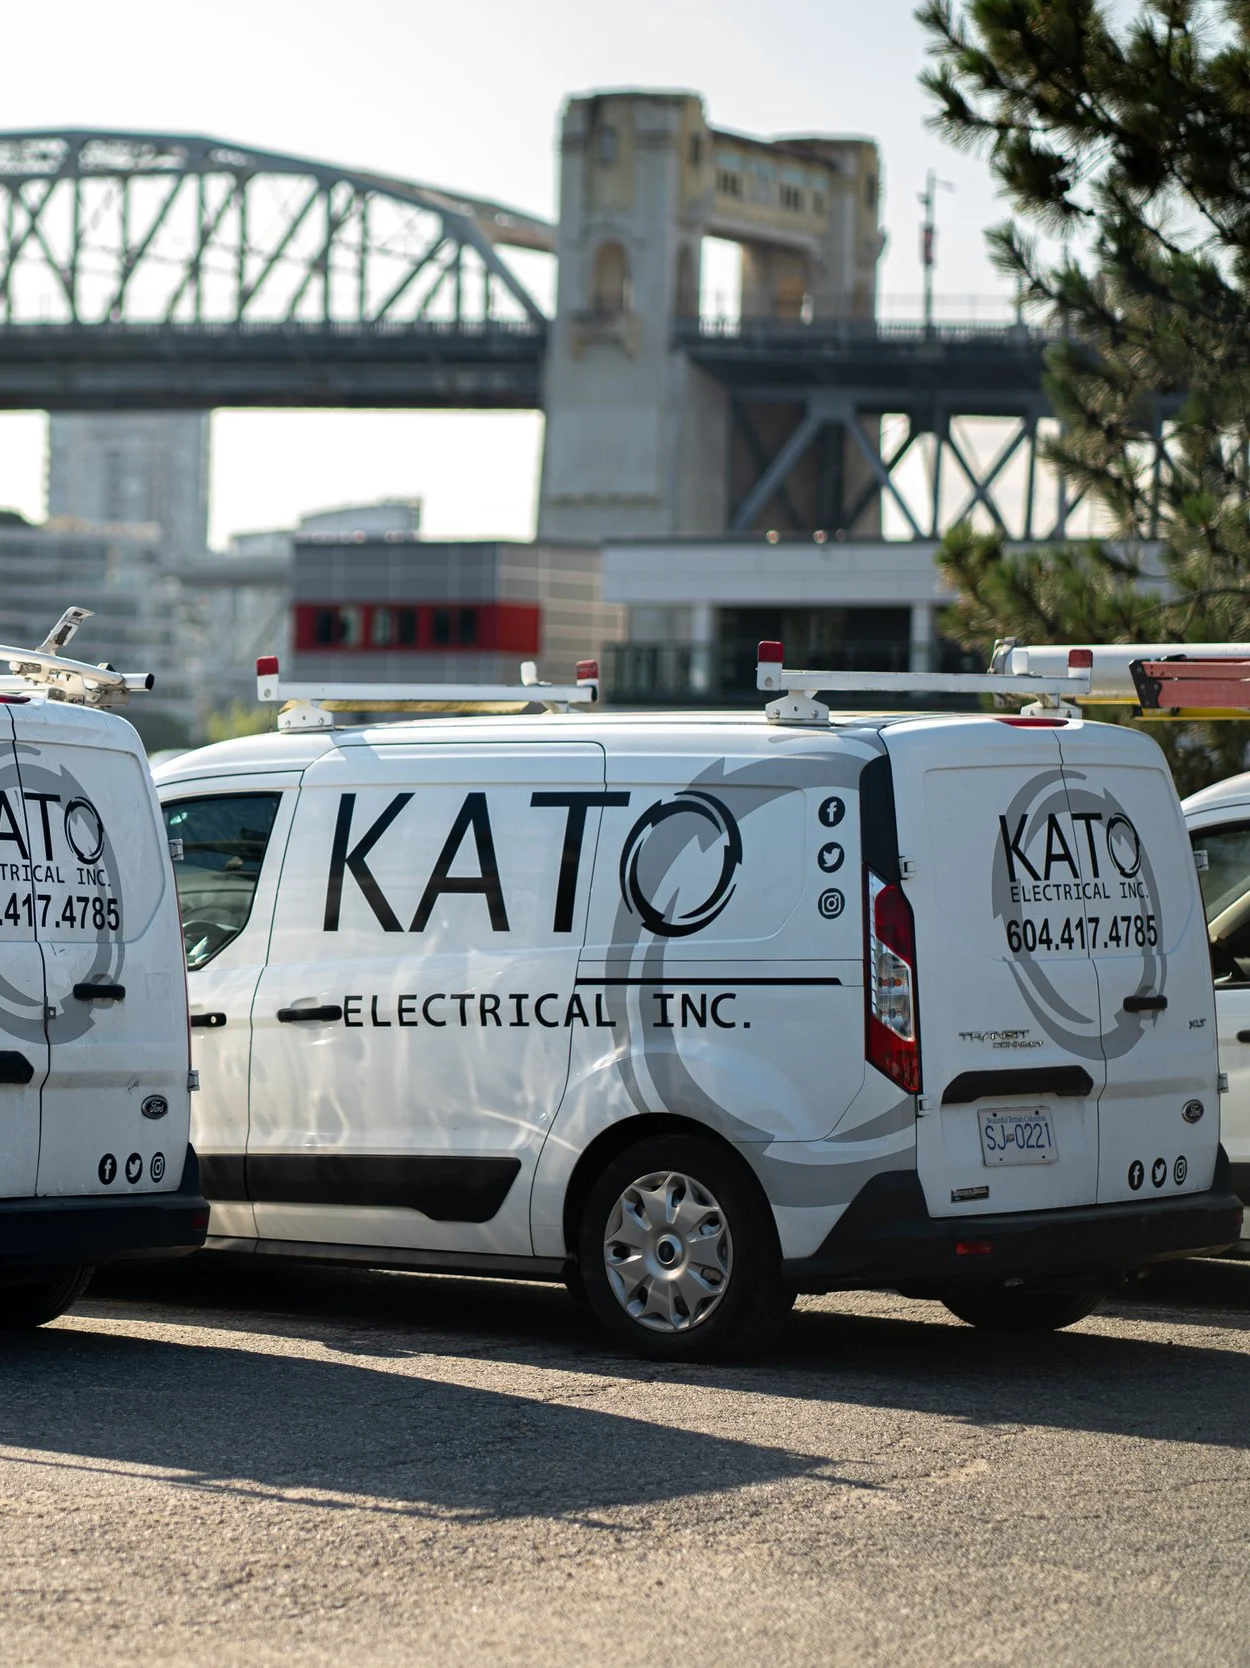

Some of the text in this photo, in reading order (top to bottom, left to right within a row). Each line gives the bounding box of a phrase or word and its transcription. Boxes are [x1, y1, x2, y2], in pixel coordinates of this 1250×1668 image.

[323, 790, 743, 938] KATO
[999, 812, 1142, 882] KATO
[76, 867, 111, 887] INC.
[1010, 881, 1150, 903] ELECTRICAL INC.
[1006, 914, 1158, 953] 604.417.4785
[343, 992, 751, 1029] ELECTRICAL INC.
[985, 1122, 1051, 1150] SJ 0221
